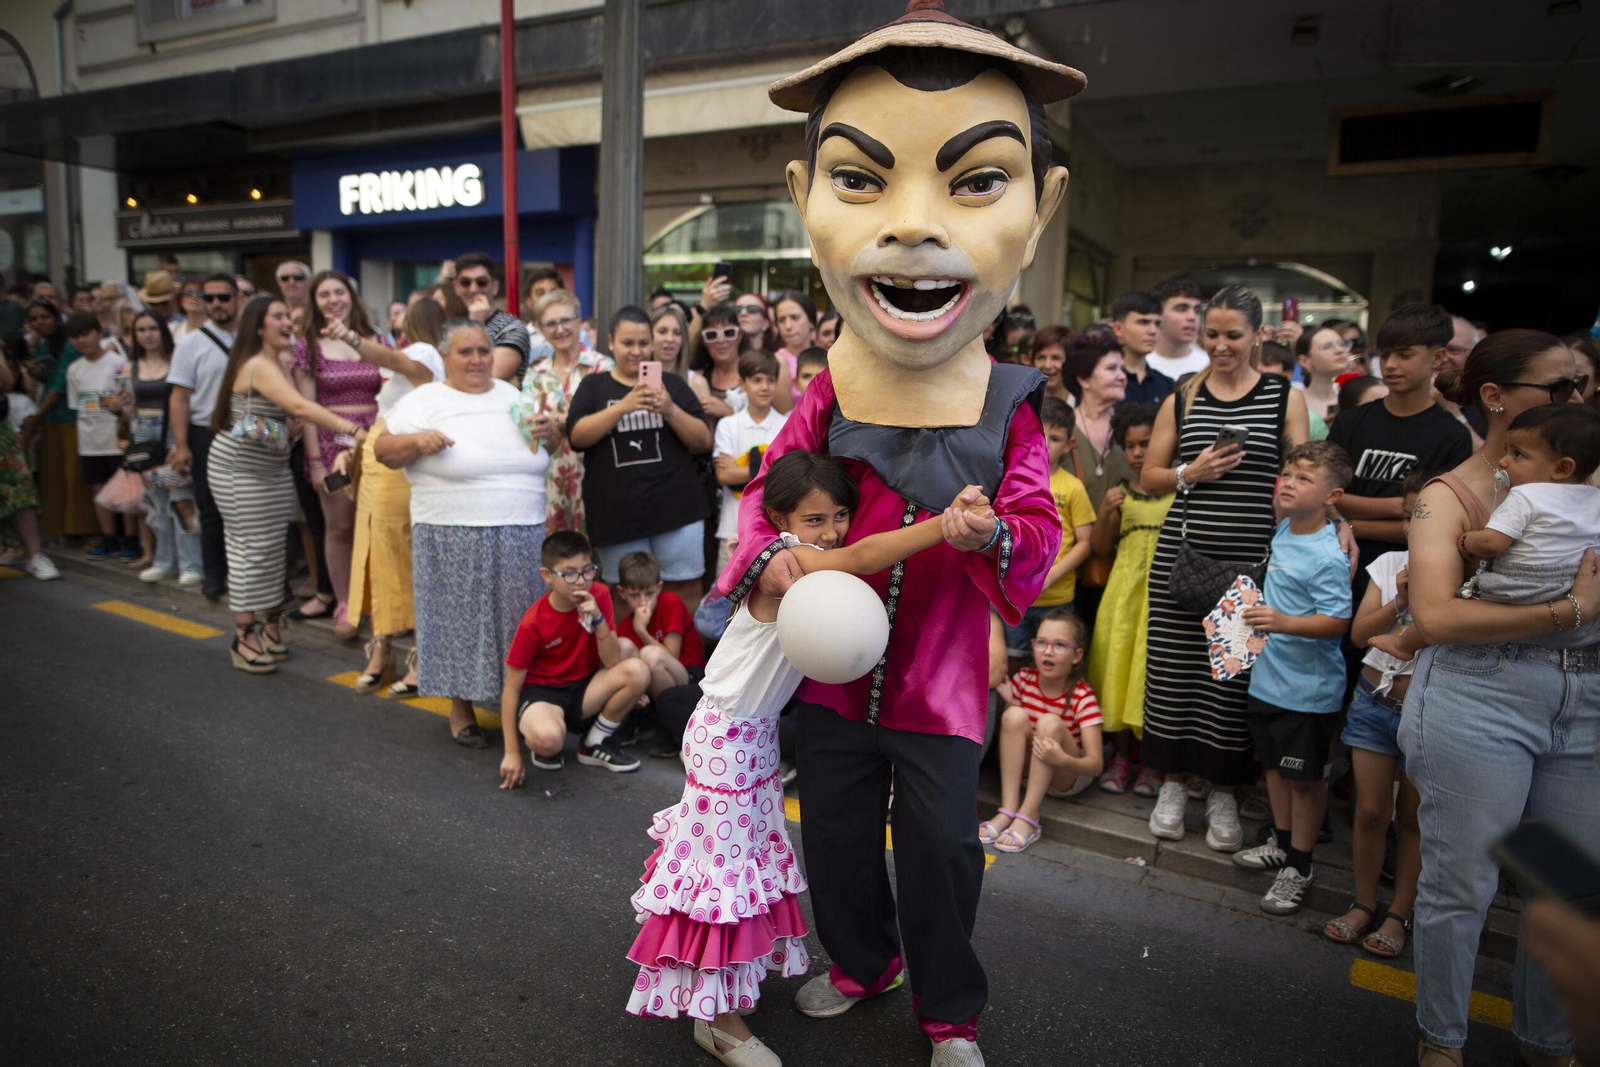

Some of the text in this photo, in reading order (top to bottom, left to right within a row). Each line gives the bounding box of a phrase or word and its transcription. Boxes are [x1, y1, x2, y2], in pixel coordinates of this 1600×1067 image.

[338, 163, 484, 216] FRIKING
[617, 409, 664, 433] UMA
[1354, 448, 1419, 483] NIKE
[1233, 607, 1251, 657] CRPUS
[1280, 756, 1305, 770] NIKE
